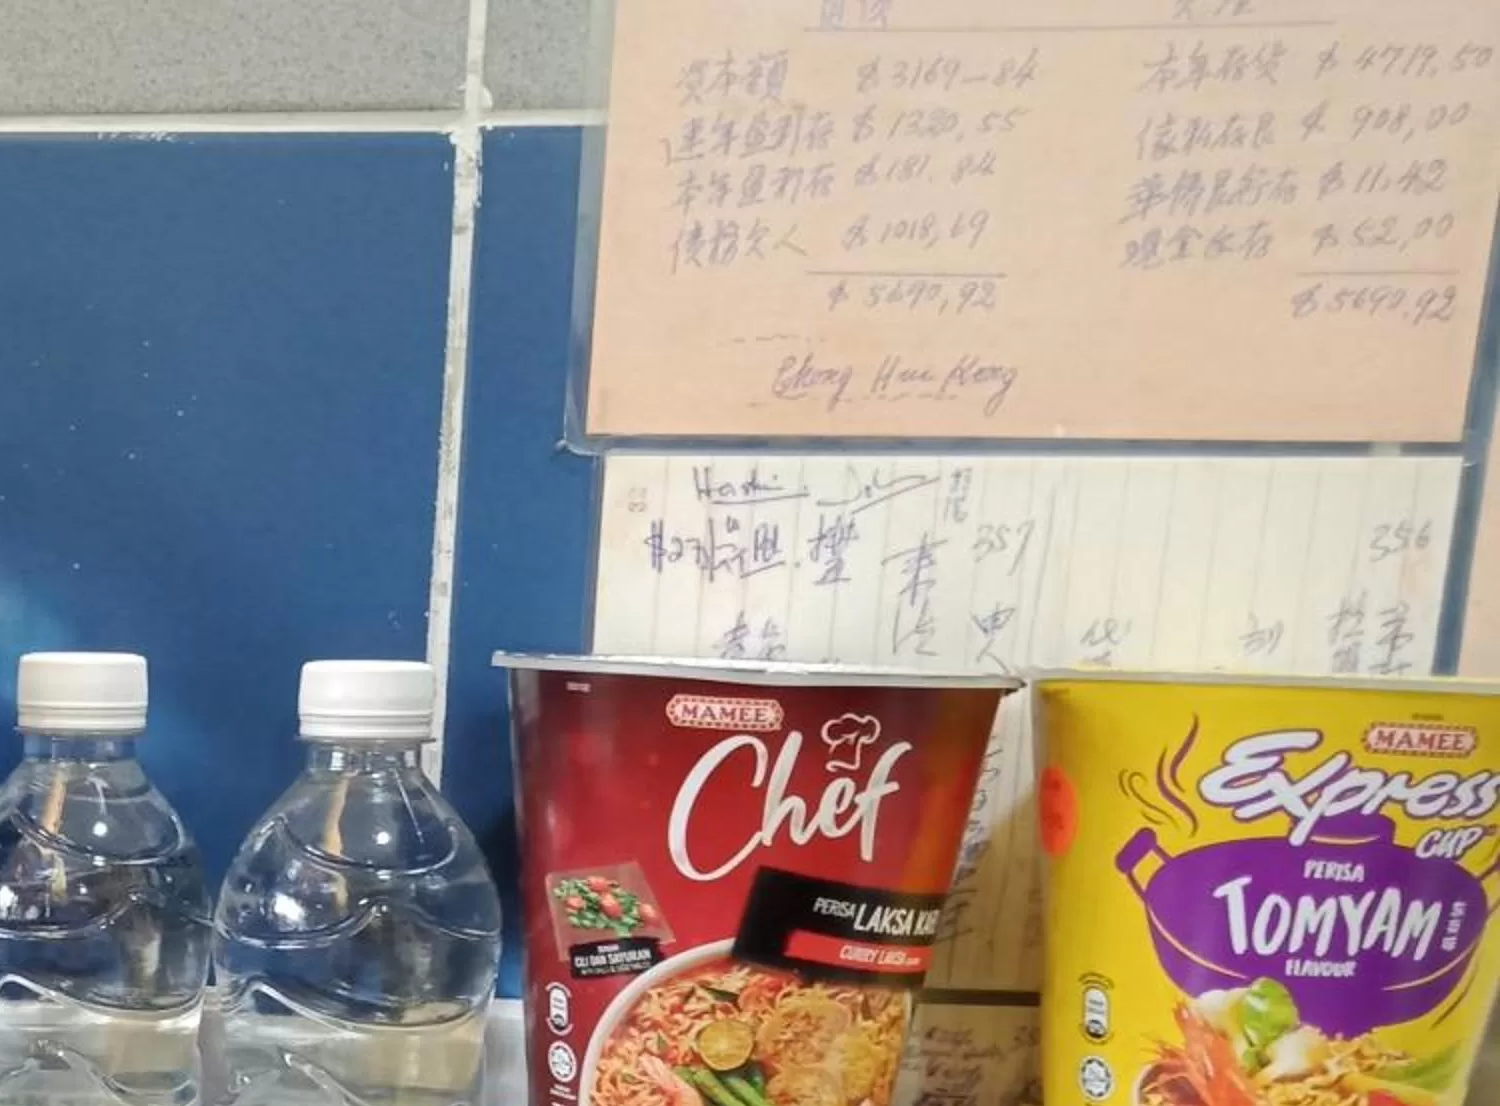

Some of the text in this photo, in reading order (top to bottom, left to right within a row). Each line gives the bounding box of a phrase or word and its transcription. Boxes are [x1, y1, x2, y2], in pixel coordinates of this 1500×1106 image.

[681, 703, 770, 724] MAMEE
[1374, 728, 1468, 752] MAMEE
[1197, 728, 1500, 848] Express
[667, 730, 913, 882] Chef
[1304, 859, 1367, 883] PERISA
[813, 897, 916, 936] PERISA LAKSA
[1212, 876, 1443, 962] TOMYAM
[1284, 958, 1358, 979] FLAVOUR
